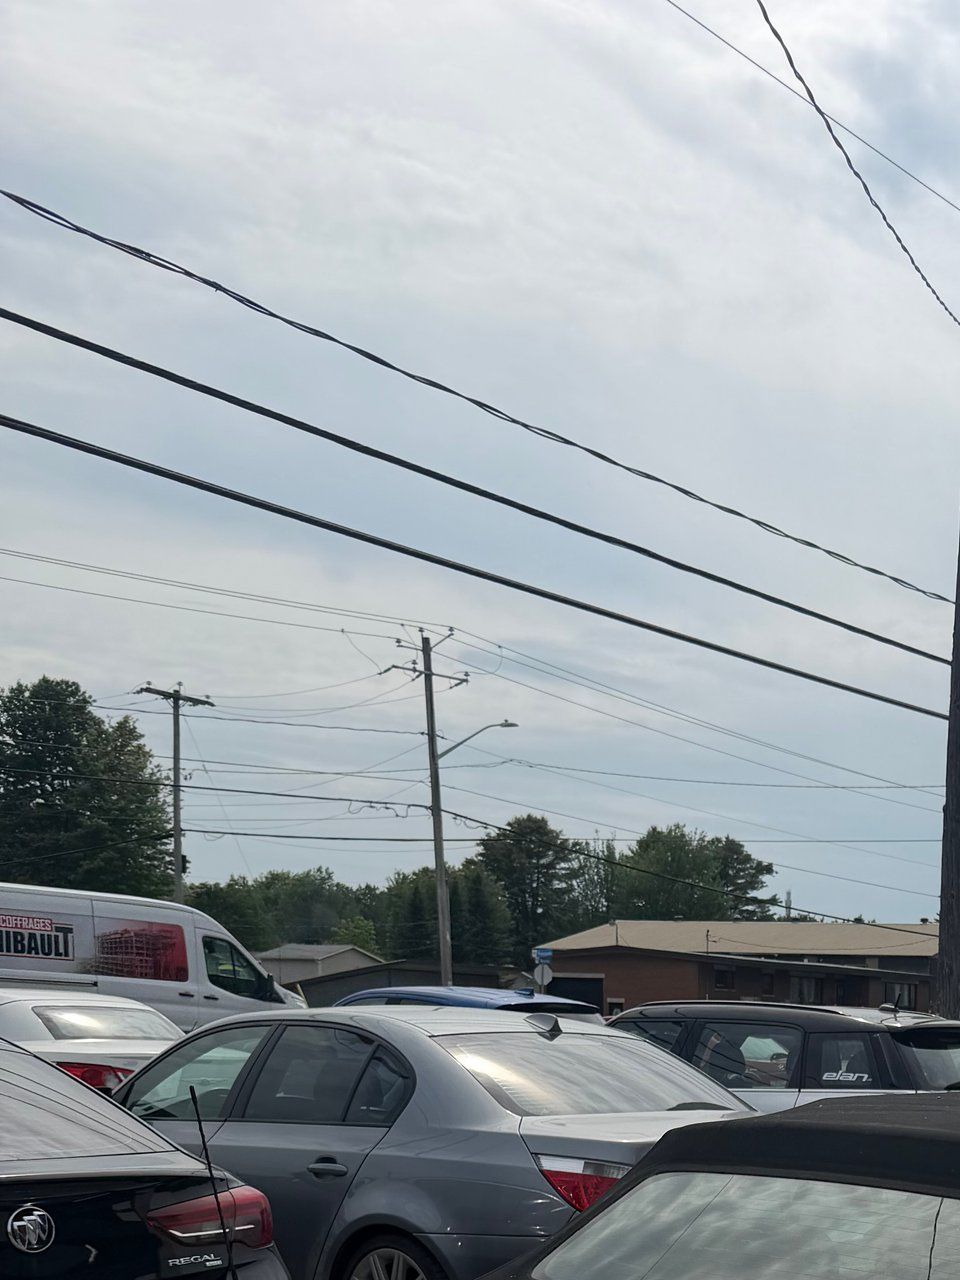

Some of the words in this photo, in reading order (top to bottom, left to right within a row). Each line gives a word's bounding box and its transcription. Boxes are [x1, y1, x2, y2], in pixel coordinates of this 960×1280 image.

[0, 915, 52, 931] COFFRAGES
[822, 1070, 869, 1082] elan
[168, 1253, 221, 1267] REGAL
